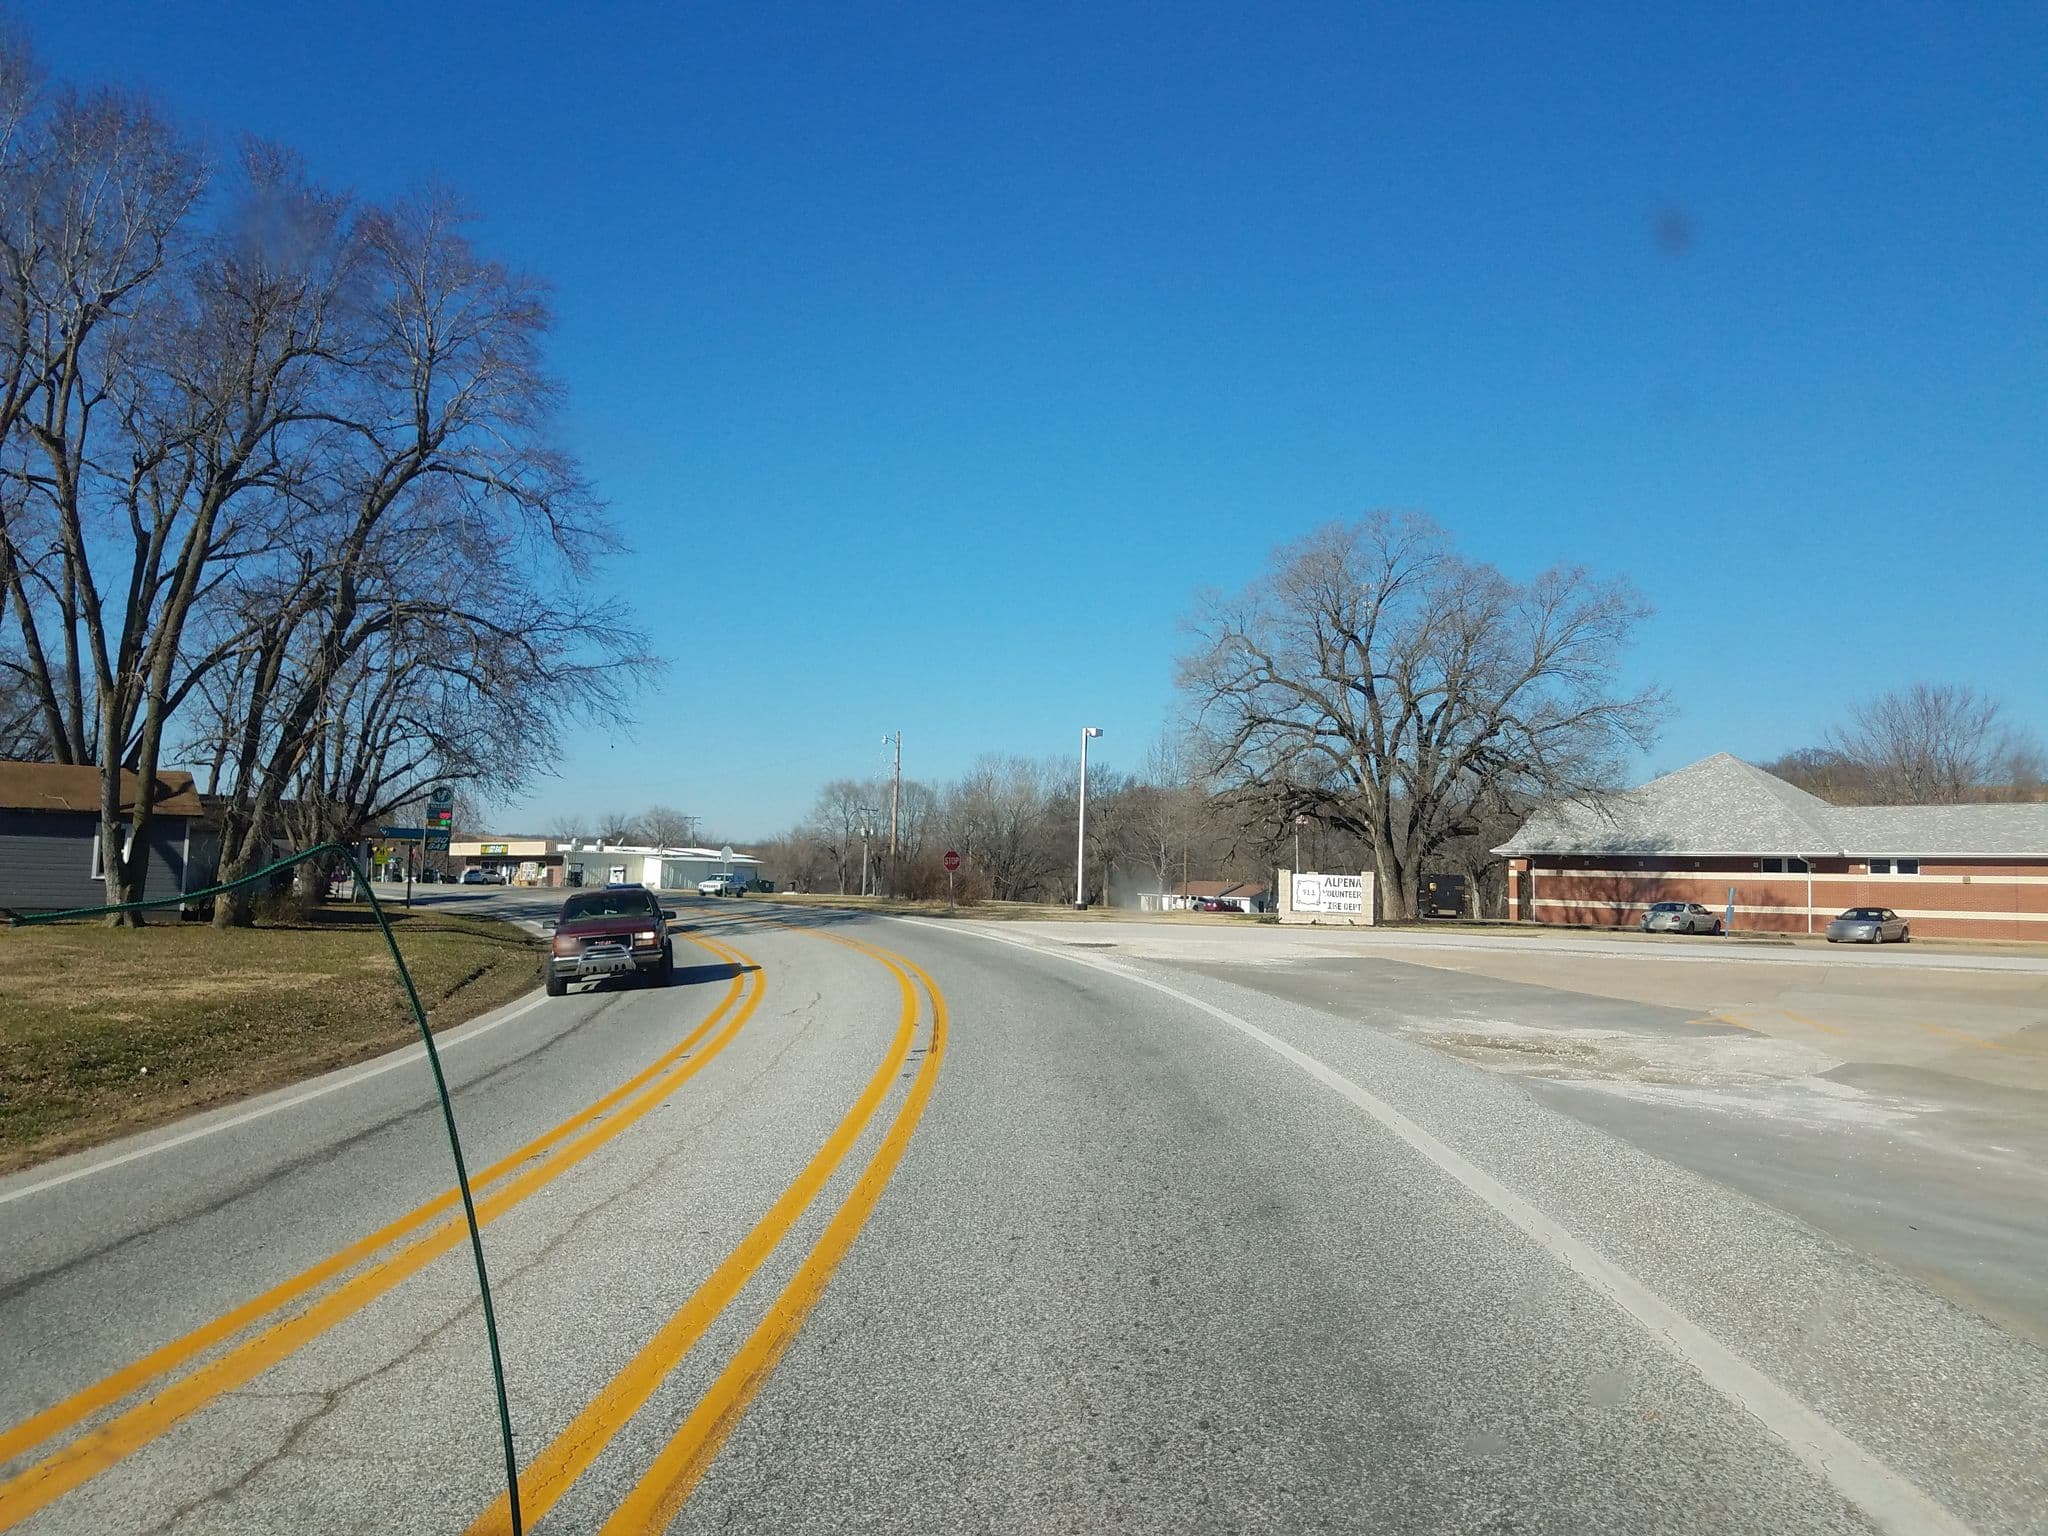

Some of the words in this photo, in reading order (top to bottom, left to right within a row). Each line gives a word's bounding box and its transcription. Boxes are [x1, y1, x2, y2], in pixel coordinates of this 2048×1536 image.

[944, 856, 960, 865] STOP
[1324, 877, 1361, 888] ALPENA
[1322, 890, 1362, 899] VOLUNTEER
[1343, 903, 1362, 911] DEPT
